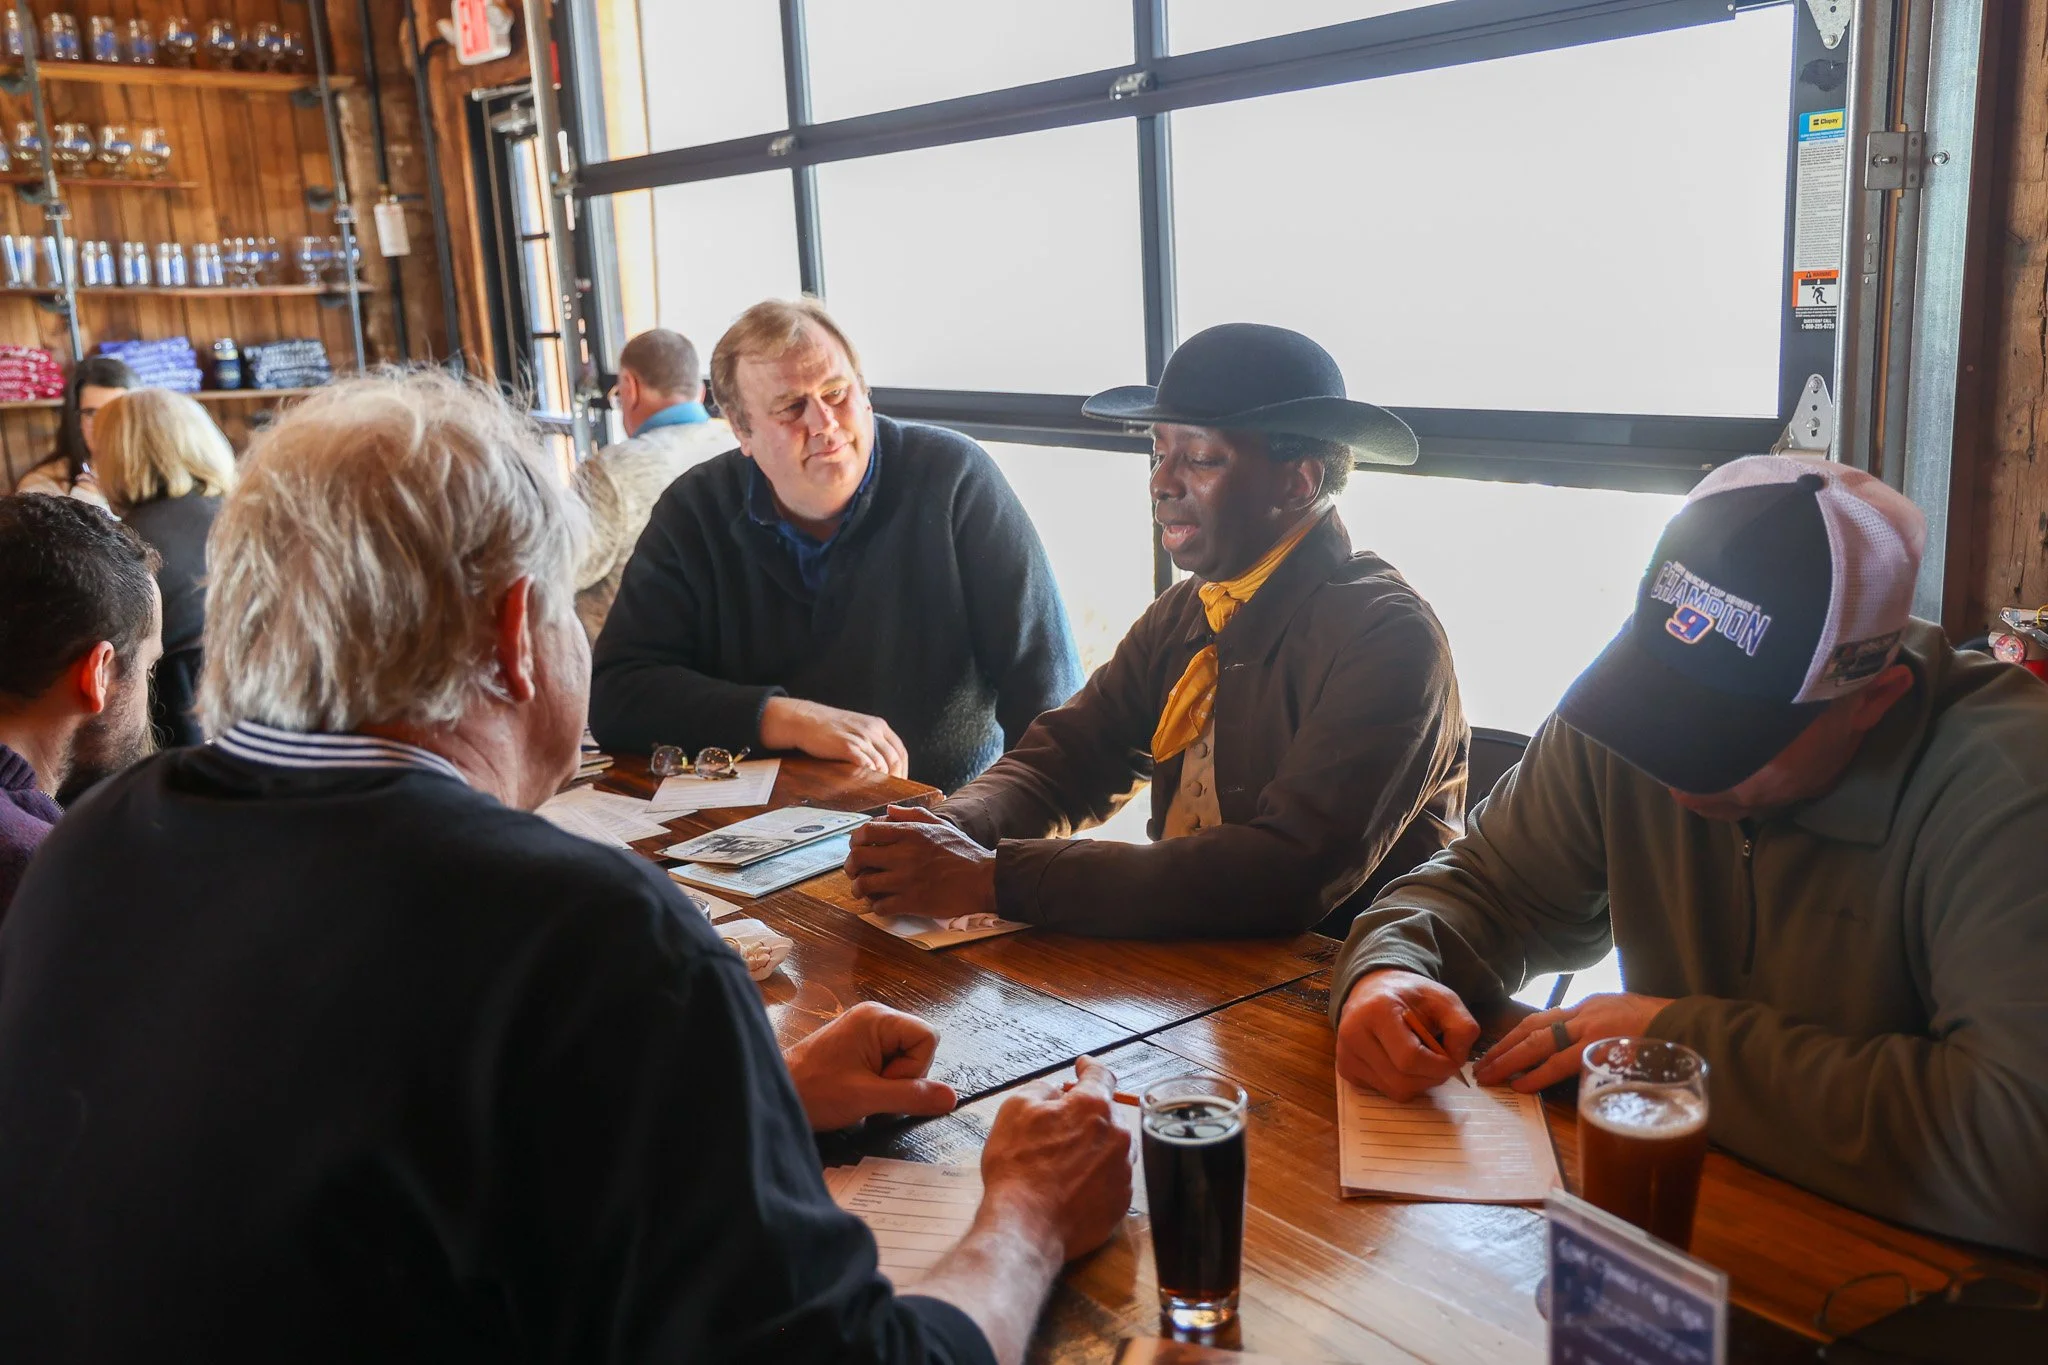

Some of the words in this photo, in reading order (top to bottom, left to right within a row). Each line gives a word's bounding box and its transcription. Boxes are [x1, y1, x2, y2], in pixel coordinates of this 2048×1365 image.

[1650, 560, 1772, 657] CHAMPION
[1709, 586, 1726, 598] CUP
[1665, 603, 1715, 645] 9
